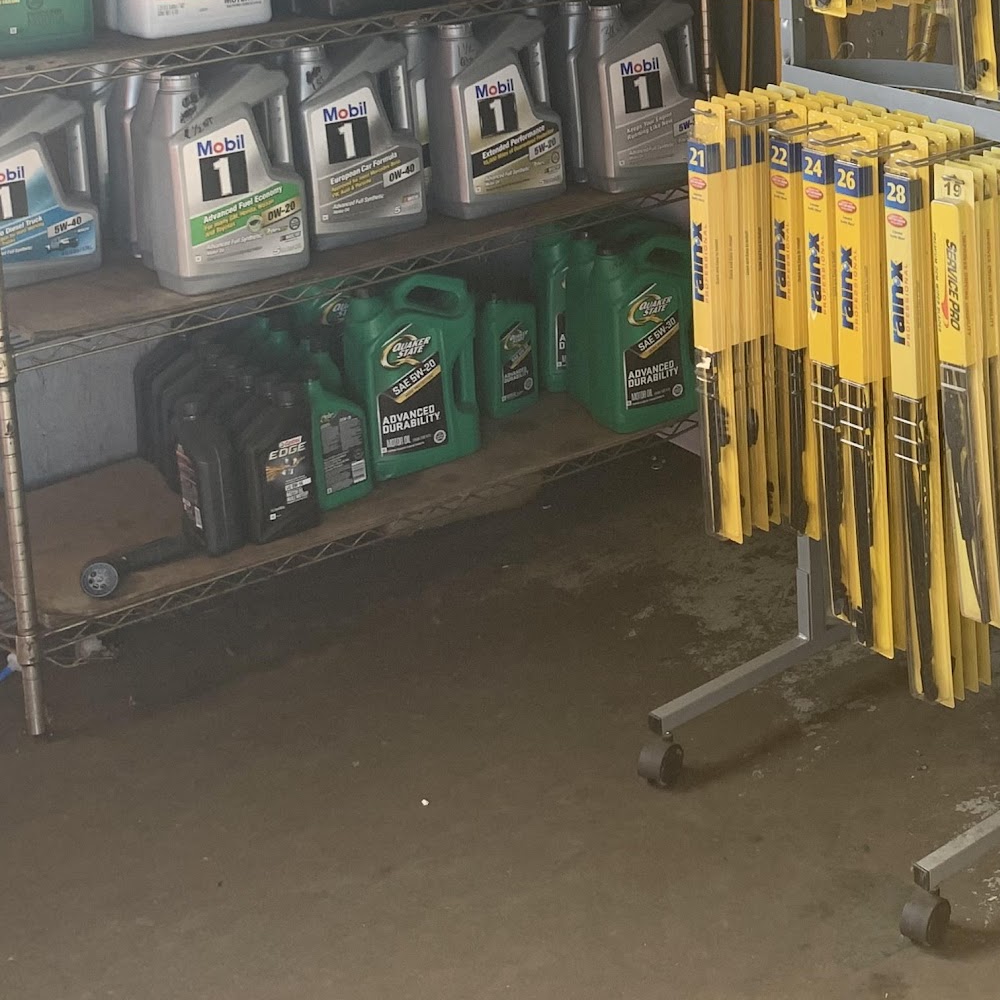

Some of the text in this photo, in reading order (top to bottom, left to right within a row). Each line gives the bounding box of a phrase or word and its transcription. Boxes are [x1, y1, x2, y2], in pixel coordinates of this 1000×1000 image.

[620, 57, 660, 76] Mobil
[474, 78, 514, 99] Mobil
[634, 76, 650, 110] 1
[322, 101, 367, 122] Mobil
[489, 98, 505, 132] 1
[197, 134, 245, 156] Mobil
[338, 122, 357, 160] 1
[482, 141, 510, 160] Extended
[510, 124, 546, 147] Performance
[690, 147, 704, 168] 21
[771, 145, 788, 166] 22
[212, 156, 233, 198] 1
[330, 168, 360, 185] European
[361, 163, 372, 172] Car
[372, 152, 398, 168] Formula
[388, 163, 415, 182] 0W-40
[804, 156, 822, 178] 24
[837, 168, 856, 190] 26
[944, 182, 962, 198] 19
[886, 182, 906, 204] 28
[204, 204, 238, 224] Advanced
[238, 198, 254, 210] Fuel
[254, 186, 283, 203] Economy
[268, 200, 296, 221] 0W-20
[6, 216, 43, 234] Diesel Truck
[54, 216, 82, 234] 5W-40
[820, 235, 828, 316] PROFESSIONAL
[946, 239, 960, 332] SERVICE PRO
[639, 296, 672, 311] QUAKER
[642, 304, 668, 316] STATE
[392, 336, 431, 353] QUAKER
[638, 316, 676, 352] SAE 5W-30
[396, 345, 424, 358] STATE
[392, 358, 436, 396] SAE 5W-20
[628, 360, 675, 380] ADVANCED
[628, 366, 679, 388] DURABILITY
[382, 404, 436, 426] ADVANCED
[382, 412, 441, 434] DURABILITY
[268, 441, 308, 460] EDGE
